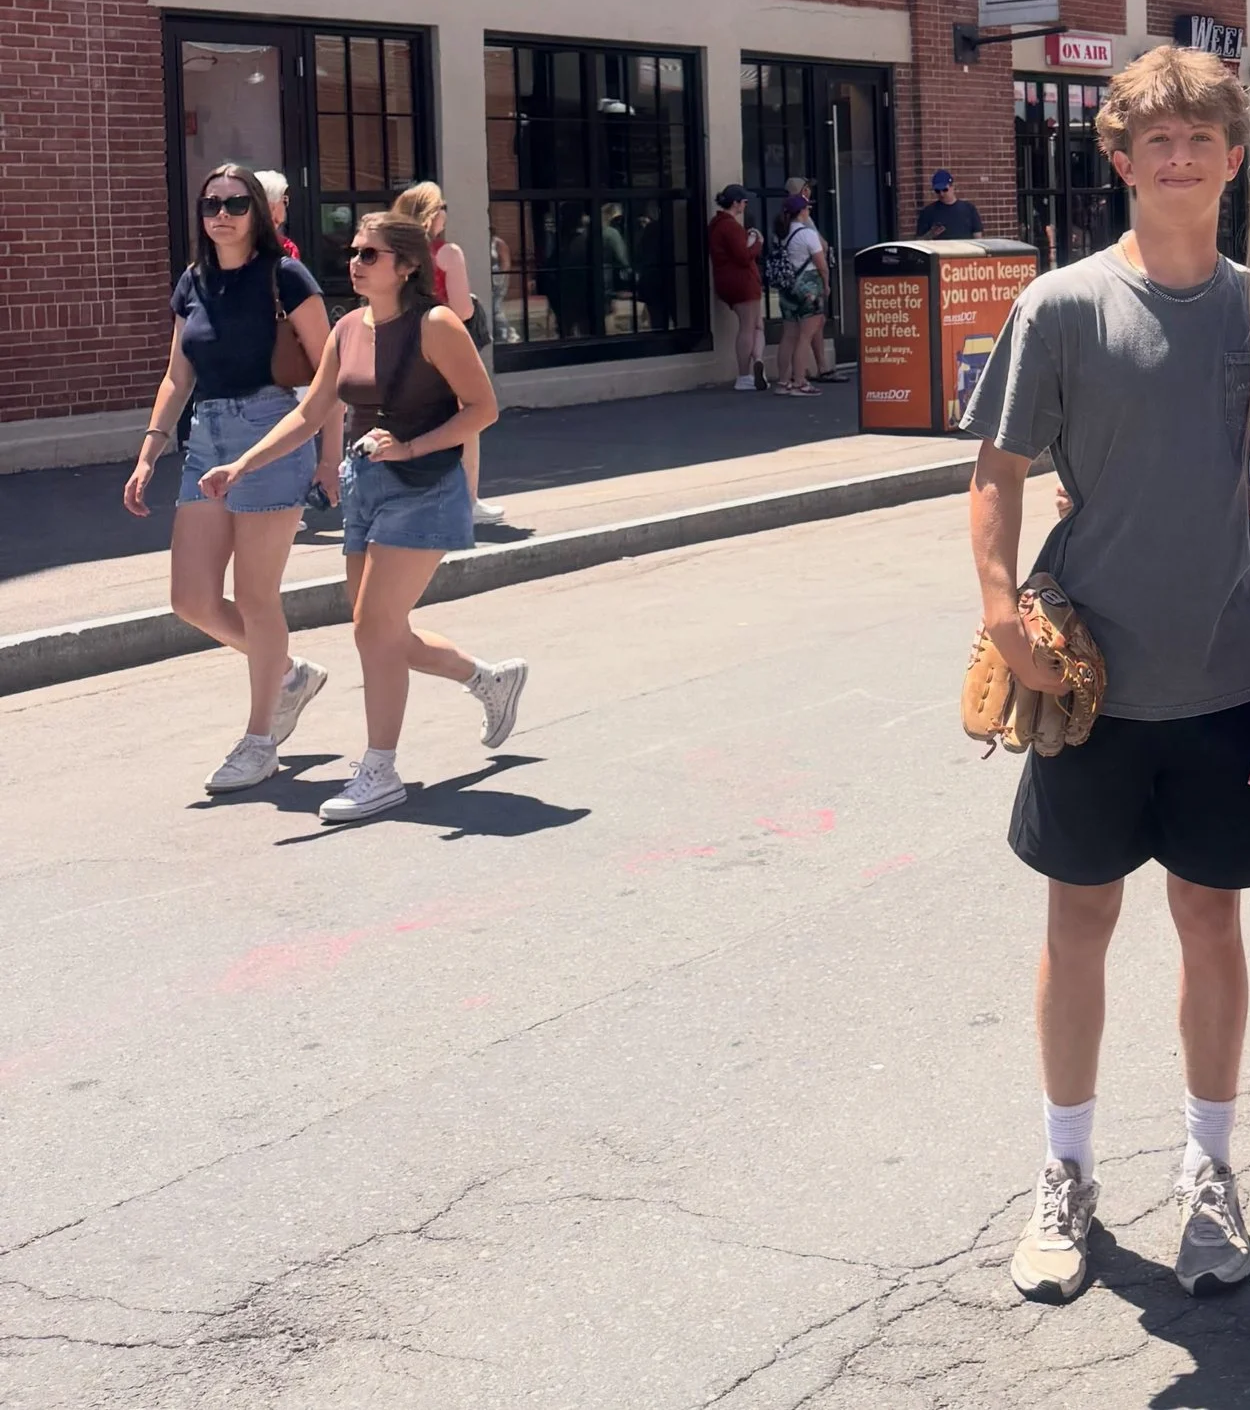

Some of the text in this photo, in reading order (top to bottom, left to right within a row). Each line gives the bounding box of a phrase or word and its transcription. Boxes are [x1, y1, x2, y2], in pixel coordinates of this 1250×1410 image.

[1062, 43, 1108, 61] ON AIR
[941, 261, 1037, 283] Caution keeps
[864, 281, 920, 295] Scan the
[865, 295, 923, 309] street for
[942, 288, 968, 310] you
[971, 287, 988, 303] on
[865, 309, 909, 324] wheels
[943, 311, 978, 323] massDOT
[865, 323, 920, 338] and feet.
[864, 345, 881, 354] Look
[864, 356, 879, 364] look
[866, 389, 912, 400] massDOT
